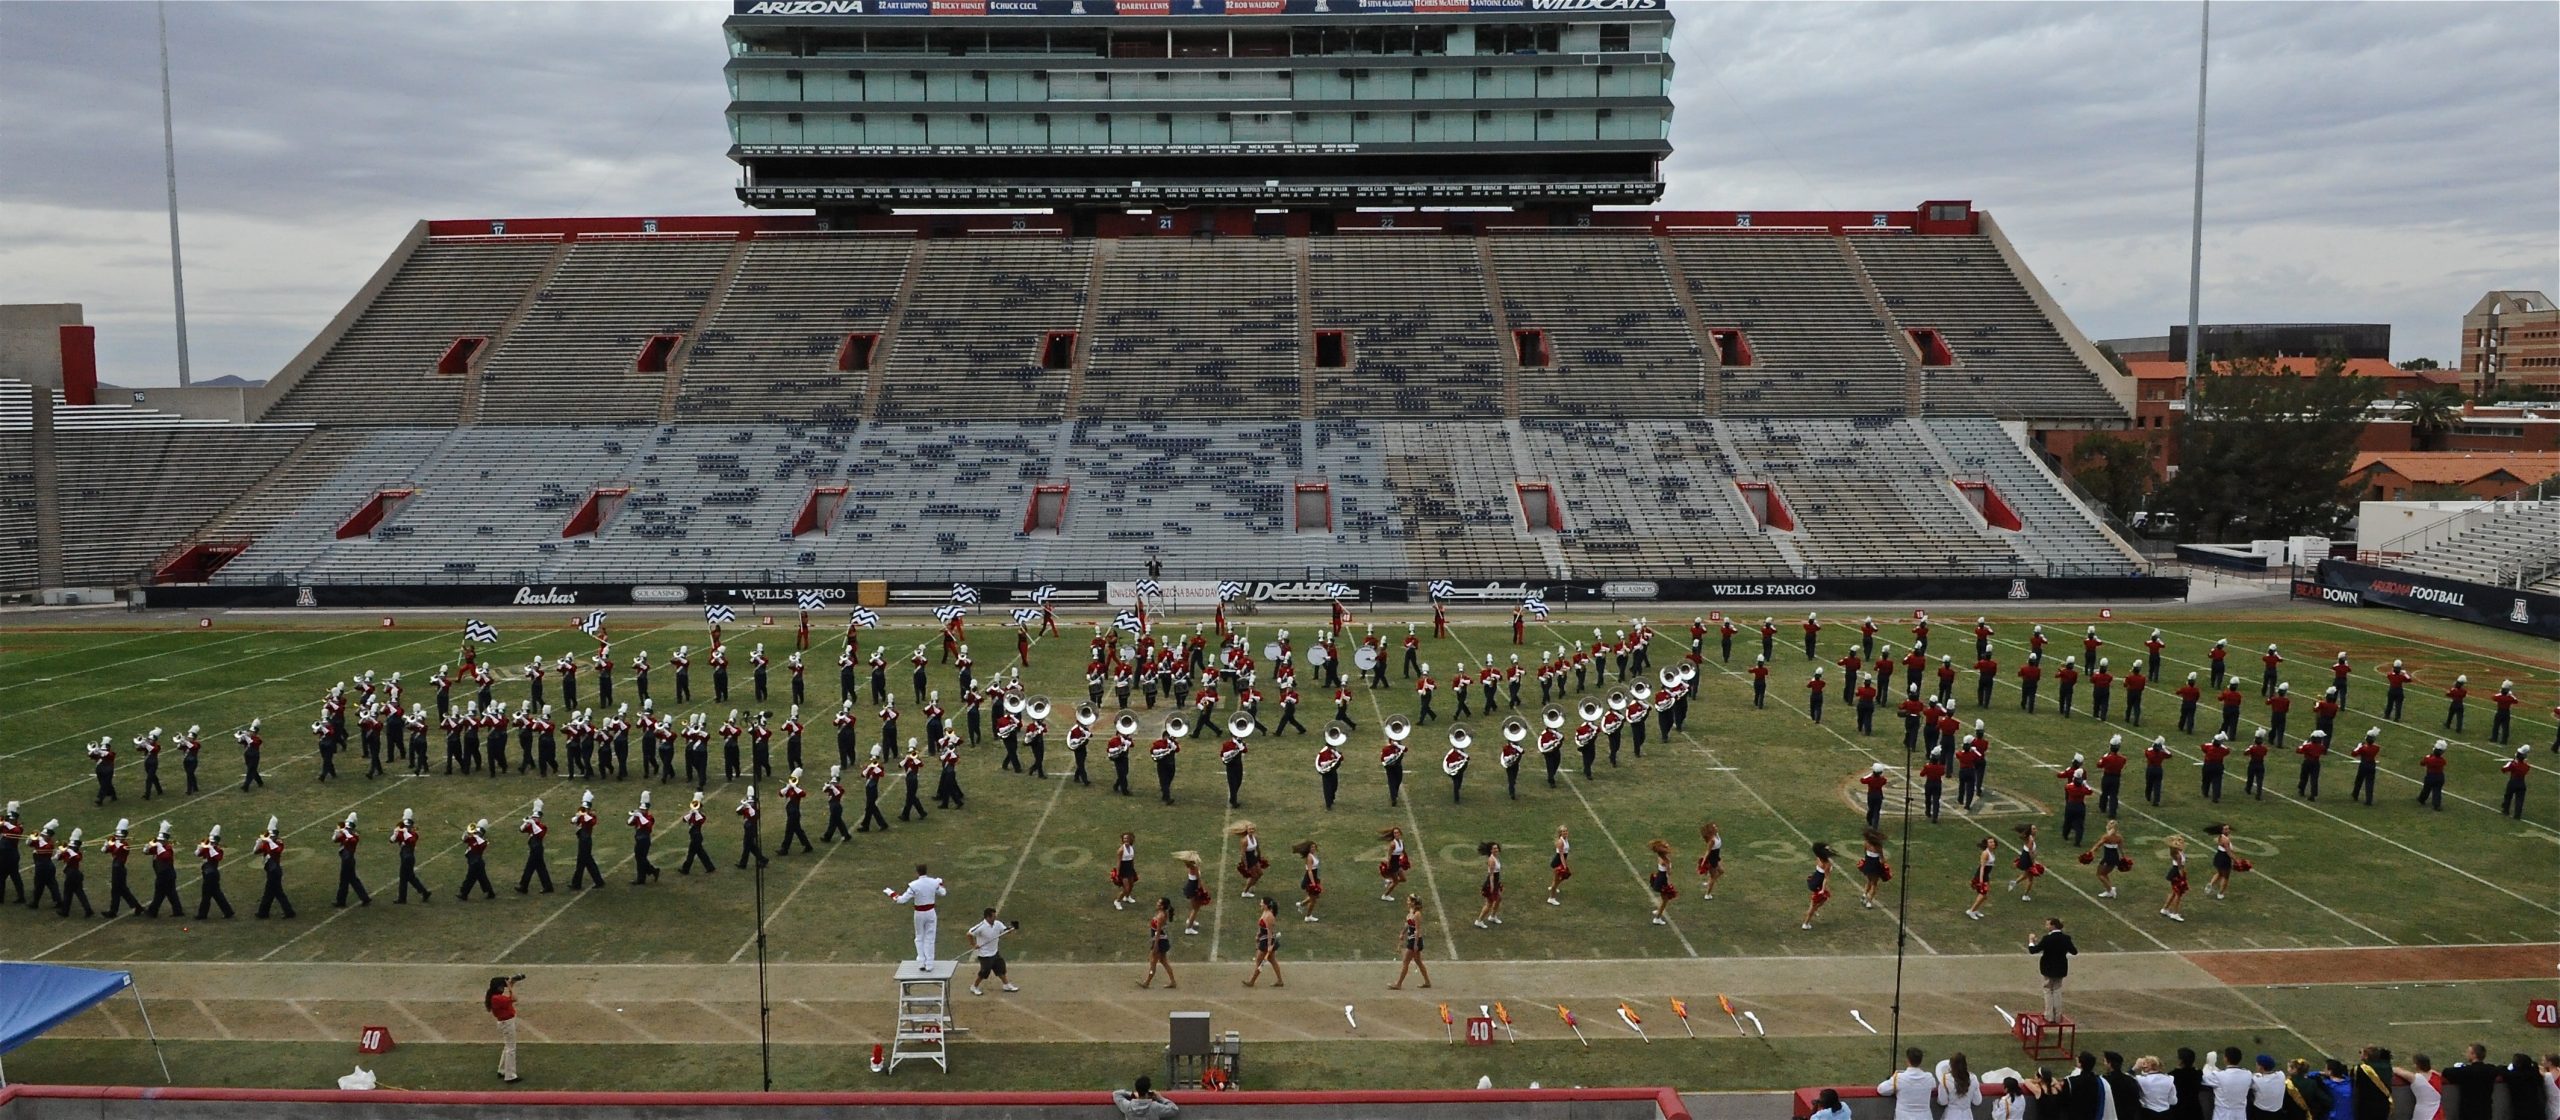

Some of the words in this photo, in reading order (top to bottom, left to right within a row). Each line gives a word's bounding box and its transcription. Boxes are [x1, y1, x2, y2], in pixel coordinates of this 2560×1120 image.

[747, 1, 863, 14] ARIZONA
[1532, 0, 1656, 10] WILDCATS
[818, 222, 829, 231] 19
[1012, 220, 1026, 229] 20
[1160, 219, 1170, 229] 21
[1382, 219, 1394, 228] 22
[1577, 218, 1590, 227] 23
[1737, 218, 1750, 227] 24
[1874, 218, 1886, 227] 25
[493, 226, 503, 235] 17
[644, 224, 656, 233] 18
[134, 392, 145, 401] 16
[513, 586, 578, 604] Bashas'
[742, 589, 793, 599] WELLS
[1712, 585, 1763, 595] WELLS
[1767, 585, 1816, 595] FARGO
[2323, 588, 2358, 604] DOWN
[2410, 586, 2465, 606] FOOTBALL
[2536, 1004, 2557, 1023] 20
[1471, 1022, 1489, 1041] 40
[362, 1030, 381, 1050] 40
